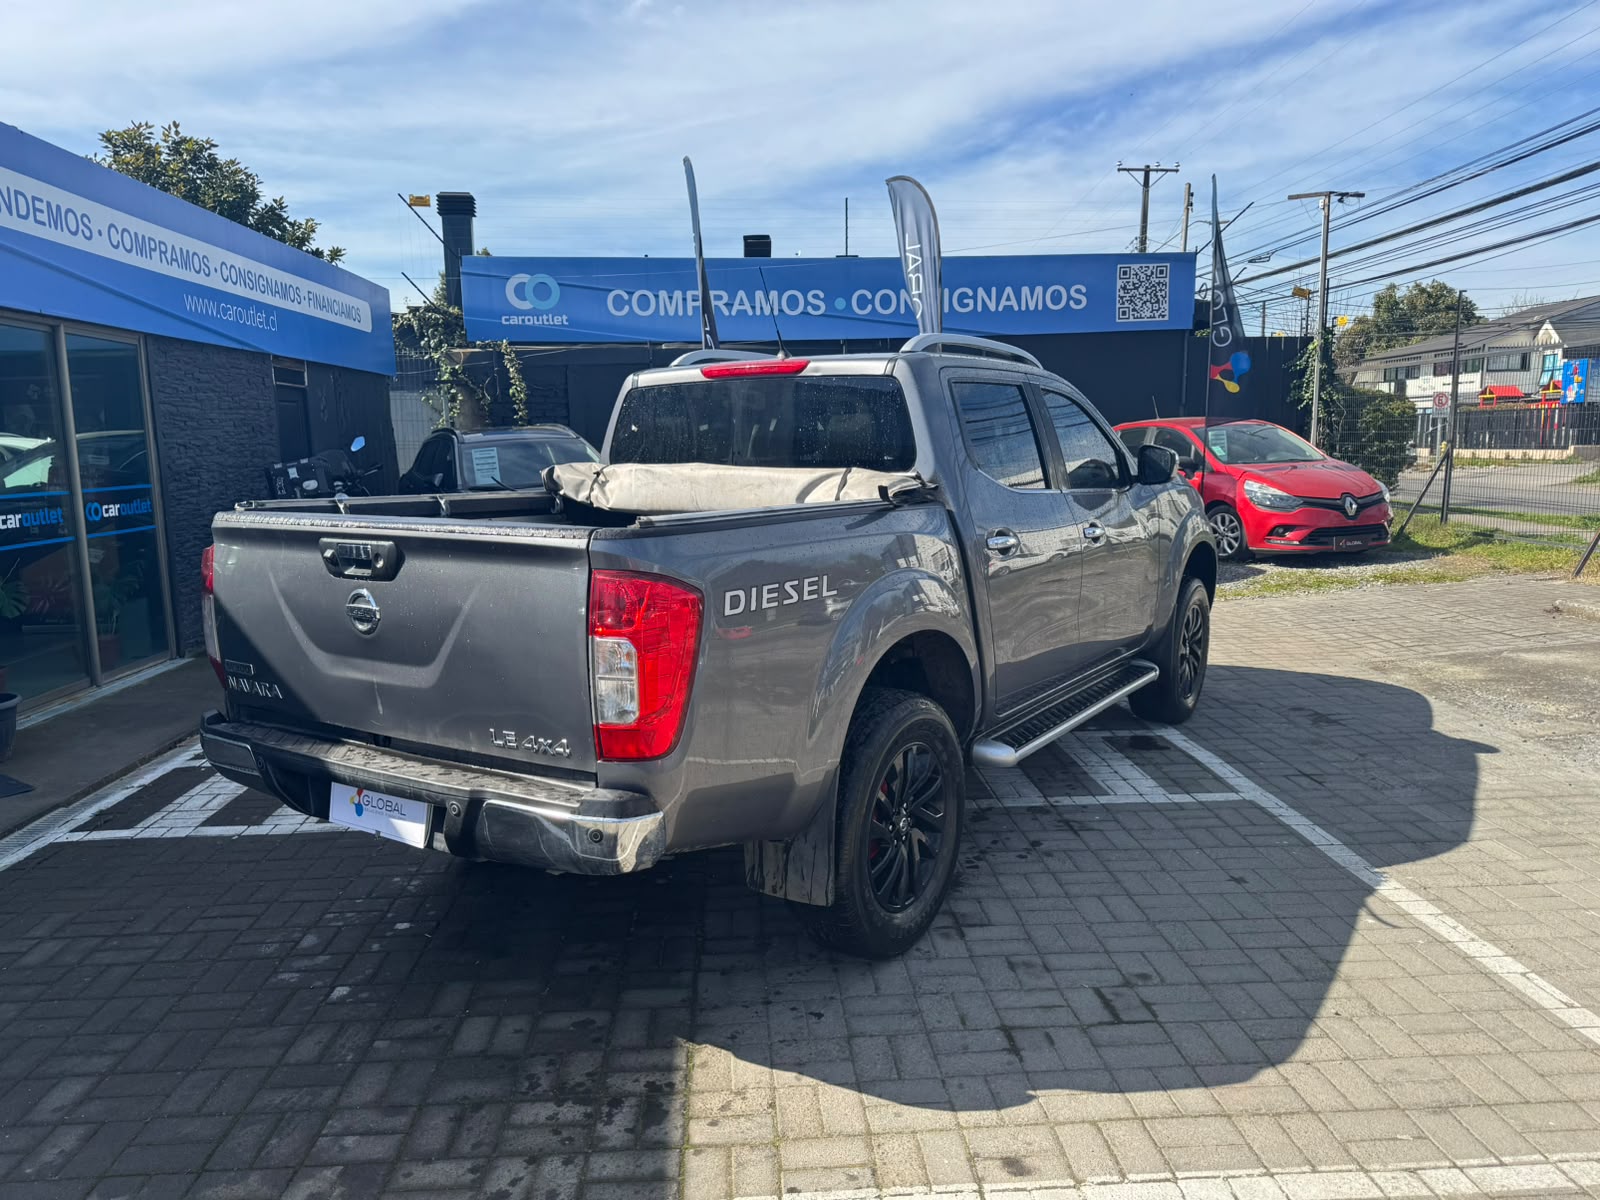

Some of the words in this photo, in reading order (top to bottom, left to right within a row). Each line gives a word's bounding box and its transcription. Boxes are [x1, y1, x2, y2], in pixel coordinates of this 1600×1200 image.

[0, 185, 93, 241] NDEMOS
[107, 222, 211, 278] COMPRAMOS
[220, 261, 302, 305] CONSIGNAMOS
[307, 289, 362, 324] FINANCIAMOS
[606, 288, 827, 317] COMPRAMOS
[851, 283, 1088, 316] CONIGNAMOS
[183, 293, 279, 332] www.caroutlet.cl
[501, 313, 569, 326] caroutlet
[0, 506, 64, 530] caroutlet
[102, 498, 153, 518] caroutlet
[723, 574, 839, 617] DIESEL
[227, 675, 283, 700] NAVARA
[489, 727, 518, 749] LE
[362, 793, 407, 817] GLOBAL
